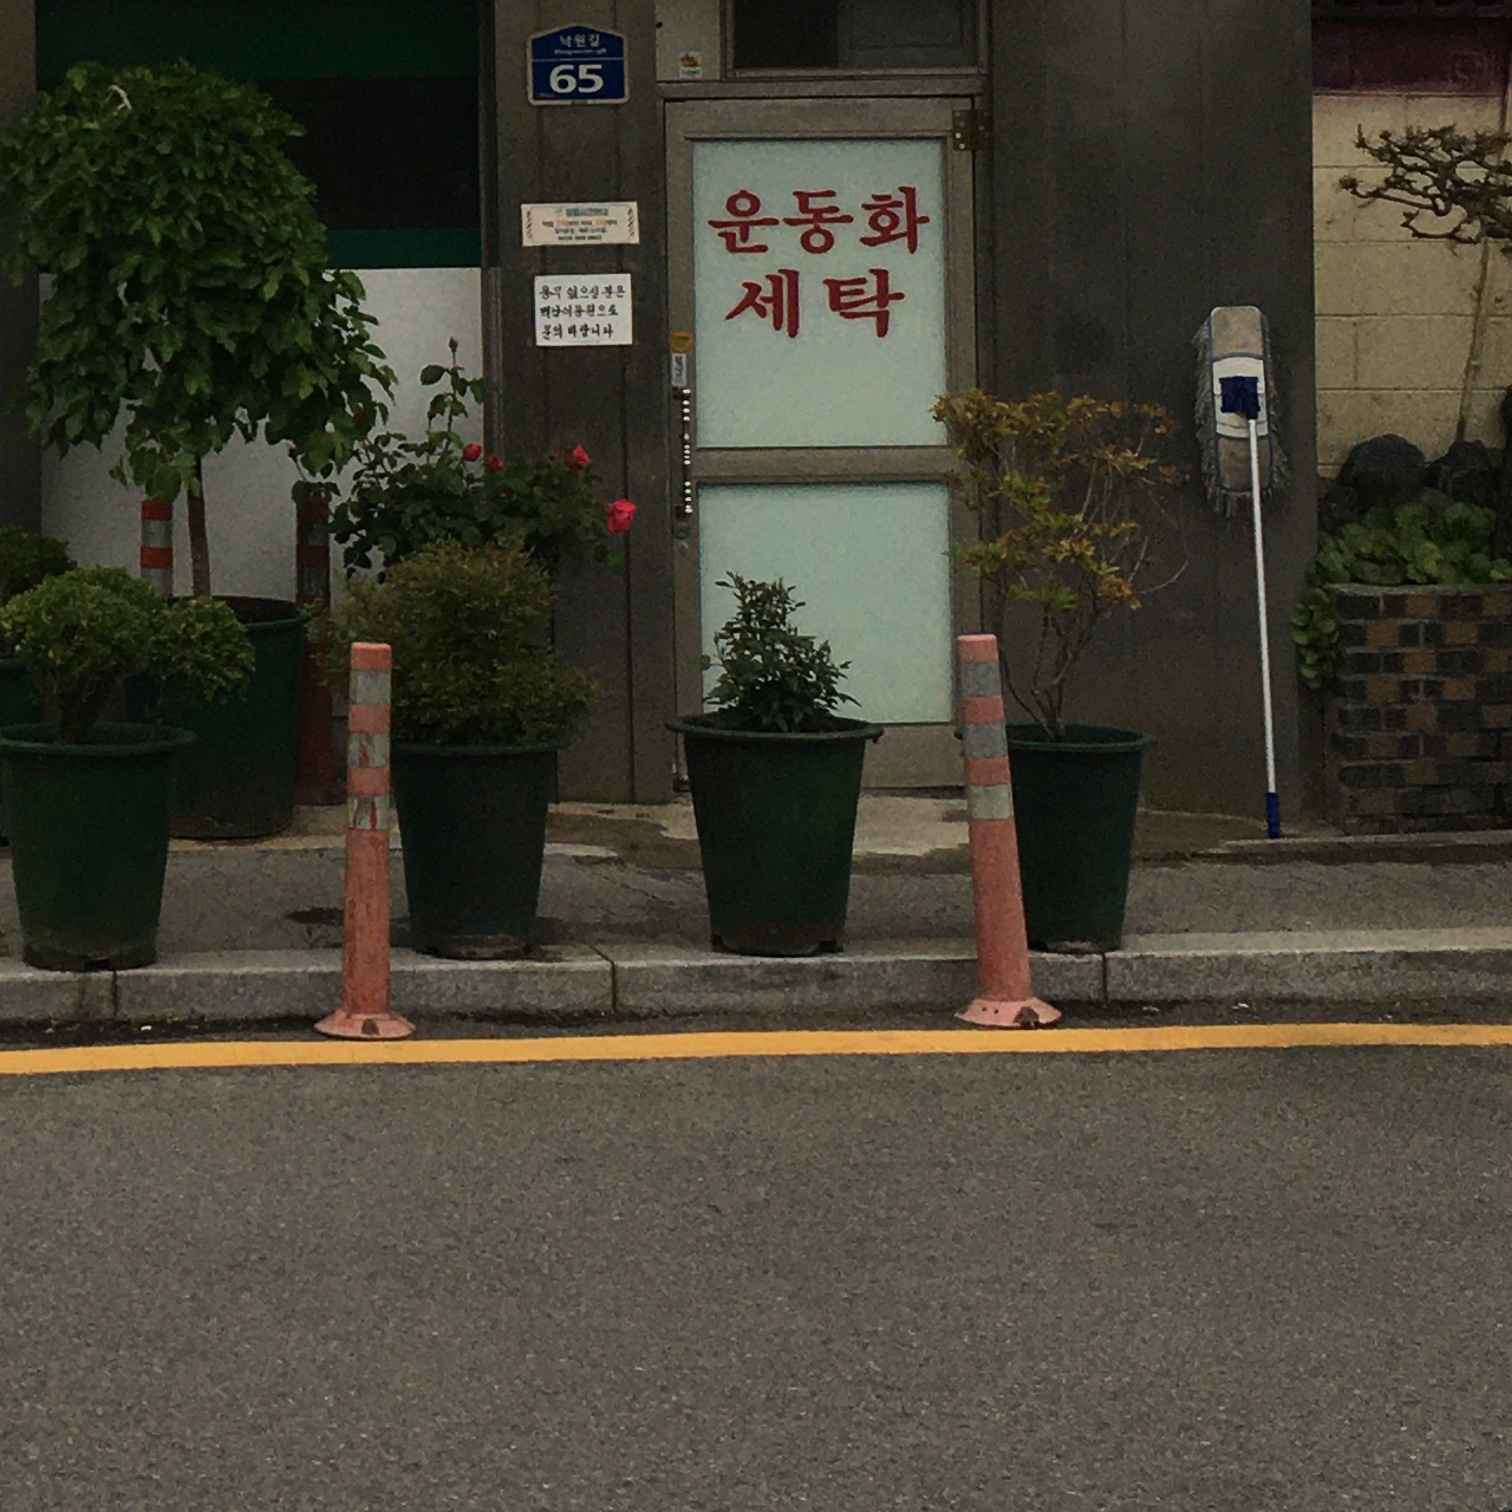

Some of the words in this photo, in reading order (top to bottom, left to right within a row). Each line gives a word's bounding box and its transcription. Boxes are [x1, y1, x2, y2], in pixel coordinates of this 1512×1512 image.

[549, 64, 604, 94] 65
[707, 185, 931, 256] 운동화
[724, 267, 905, 339] 세탁
